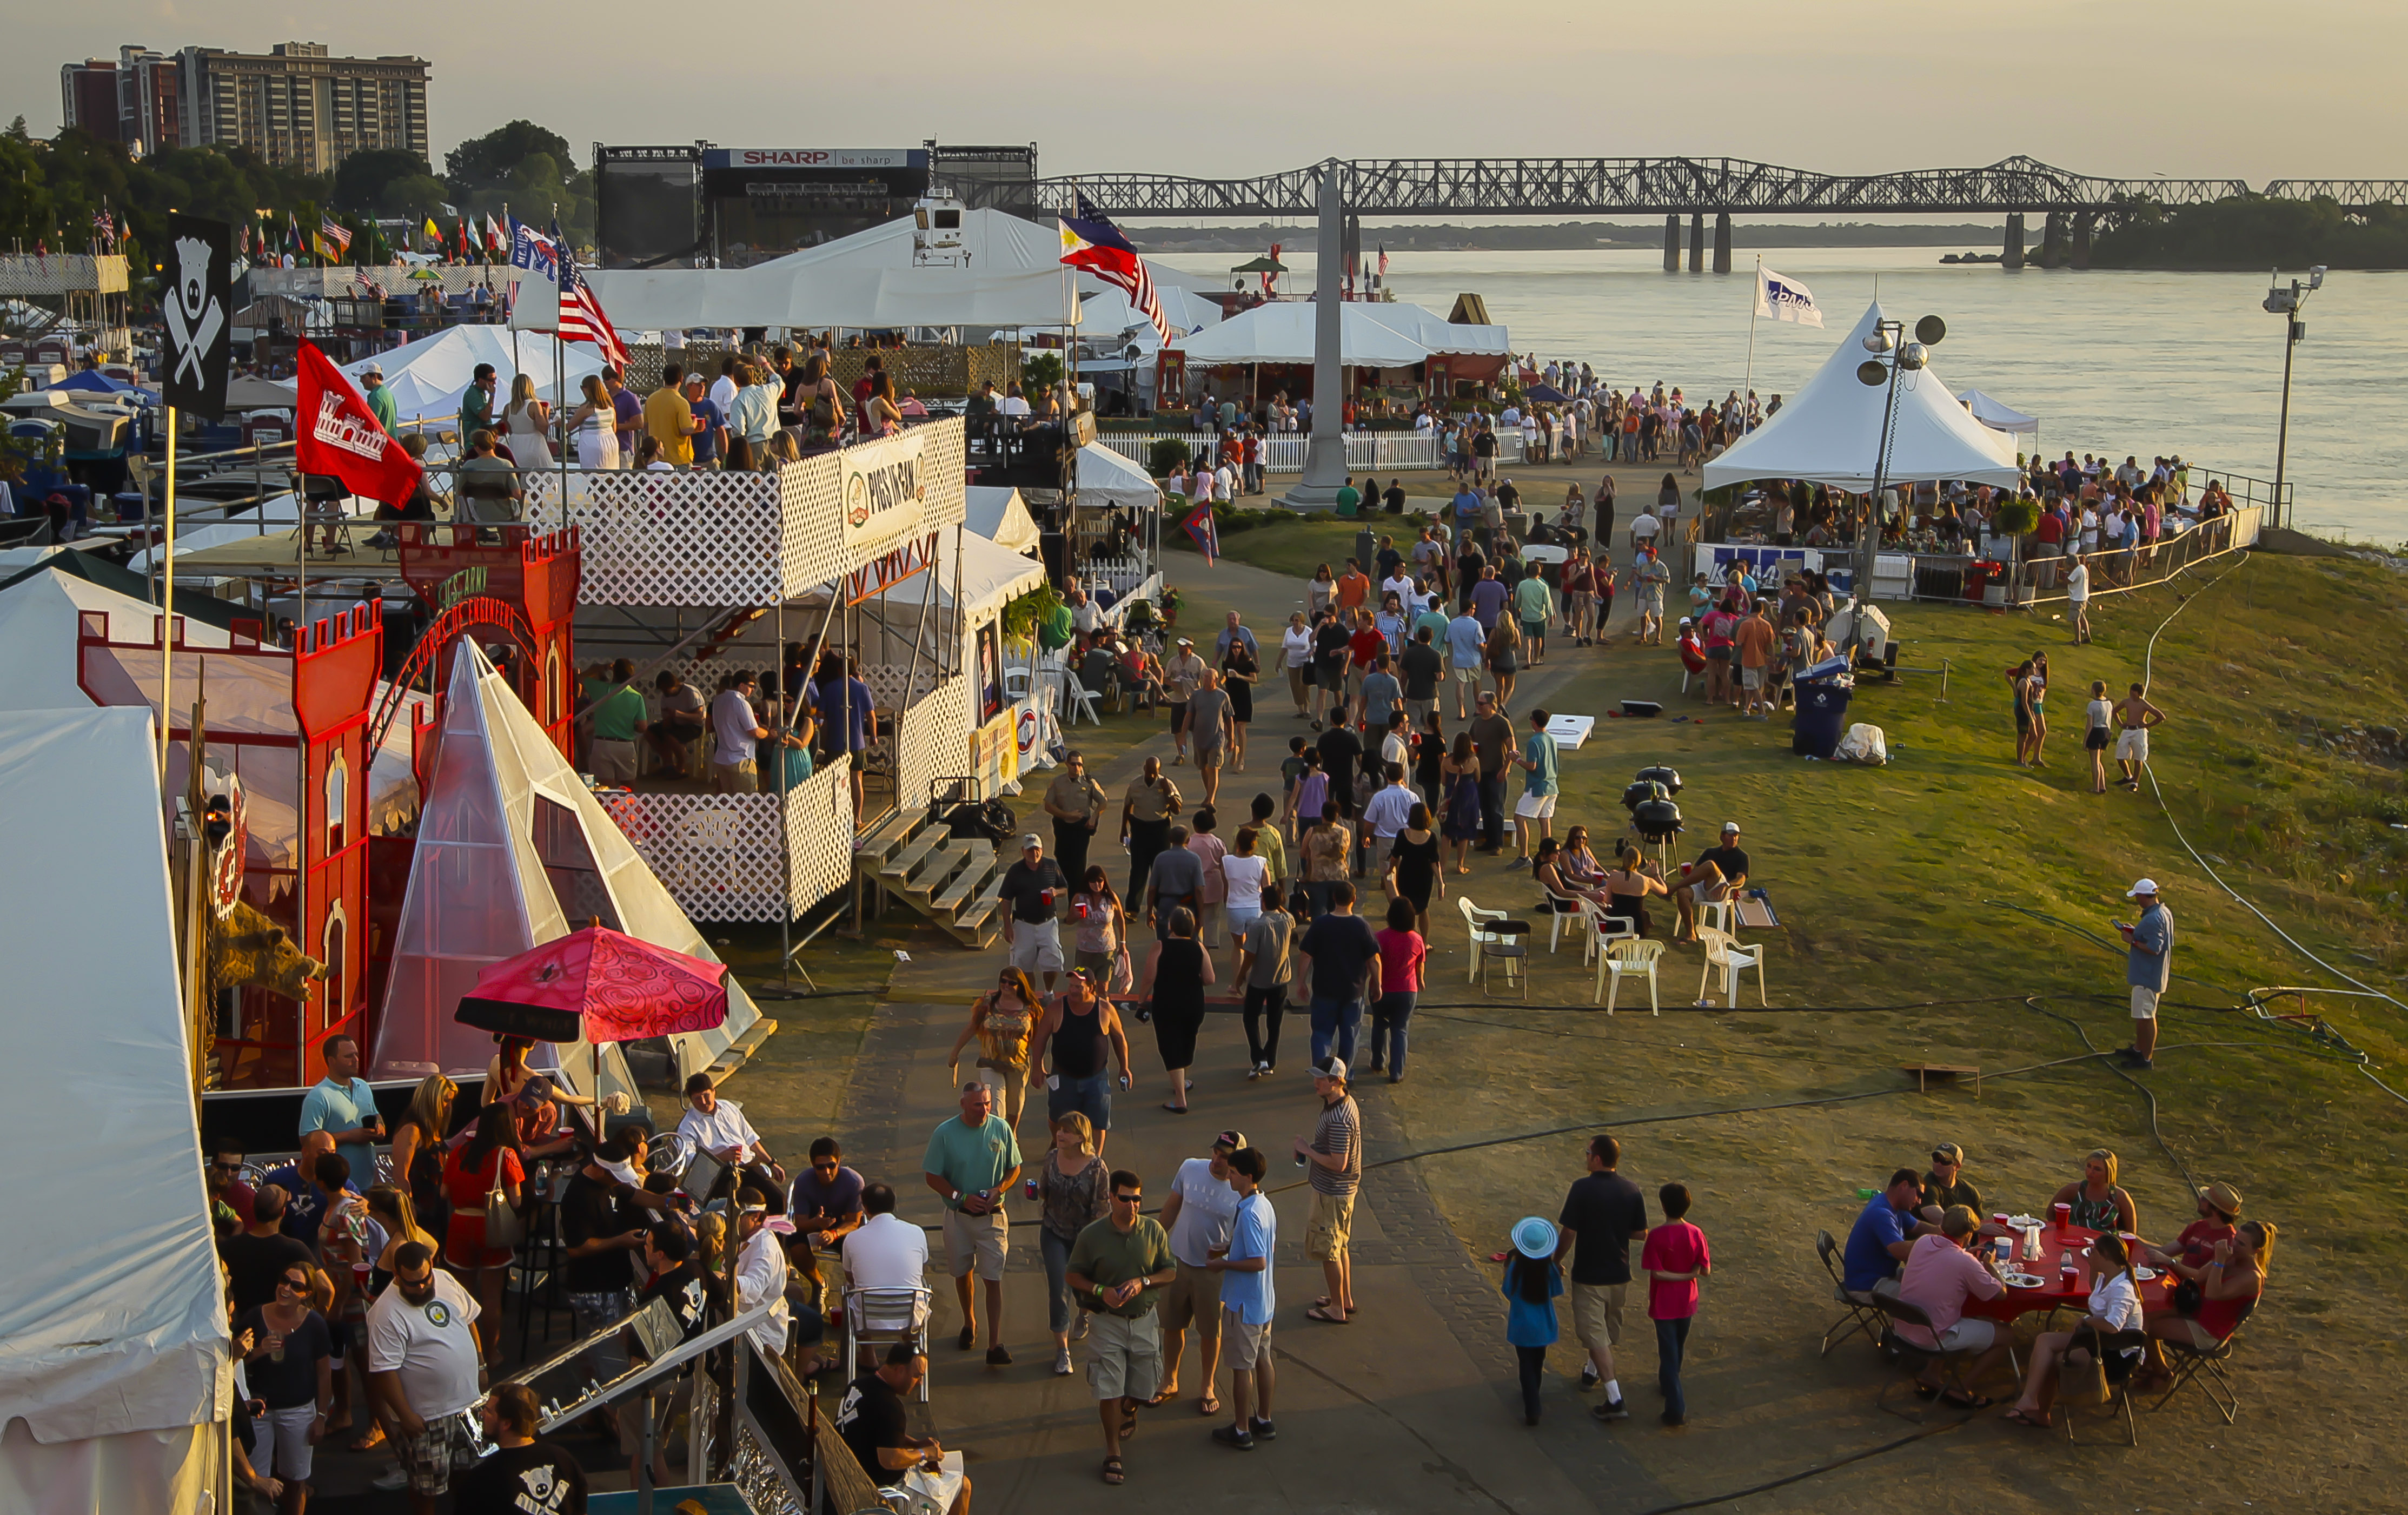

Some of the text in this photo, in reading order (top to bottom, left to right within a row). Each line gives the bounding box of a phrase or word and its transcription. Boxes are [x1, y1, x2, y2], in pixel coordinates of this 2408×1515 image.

[744, 151, 829, 164] SHARP
[841, 156, 891, 166] be sharp
[867, 467, 892, 514] PIGS
[887, 464, 902, 506] IN
[464, 566, 488, 596] ARMY
[416, 597, 514, 674] CORPS OF ENGINEERS
[982, 737, 989, 751] DO
[989, 727, 999, 746] YOU
